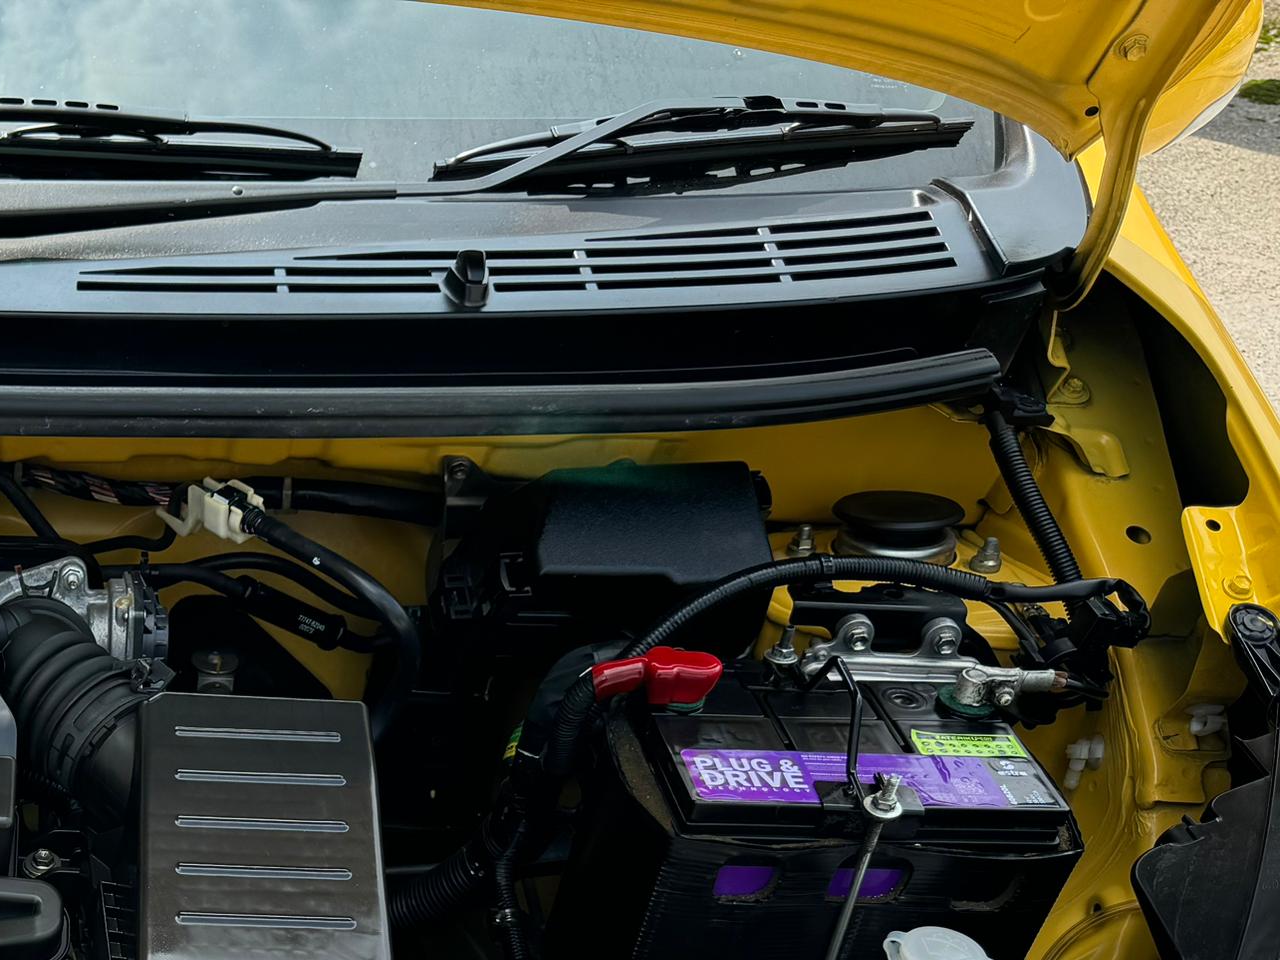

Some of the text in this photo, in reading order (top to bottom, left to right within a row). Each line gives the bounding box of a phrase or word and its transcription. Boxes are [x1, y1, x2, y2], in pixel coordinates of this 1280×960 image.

[693, 756, 773, 772] PLUG
[779, 759, 801, 773] &
[702, 770, 809, 788] DRIVE
